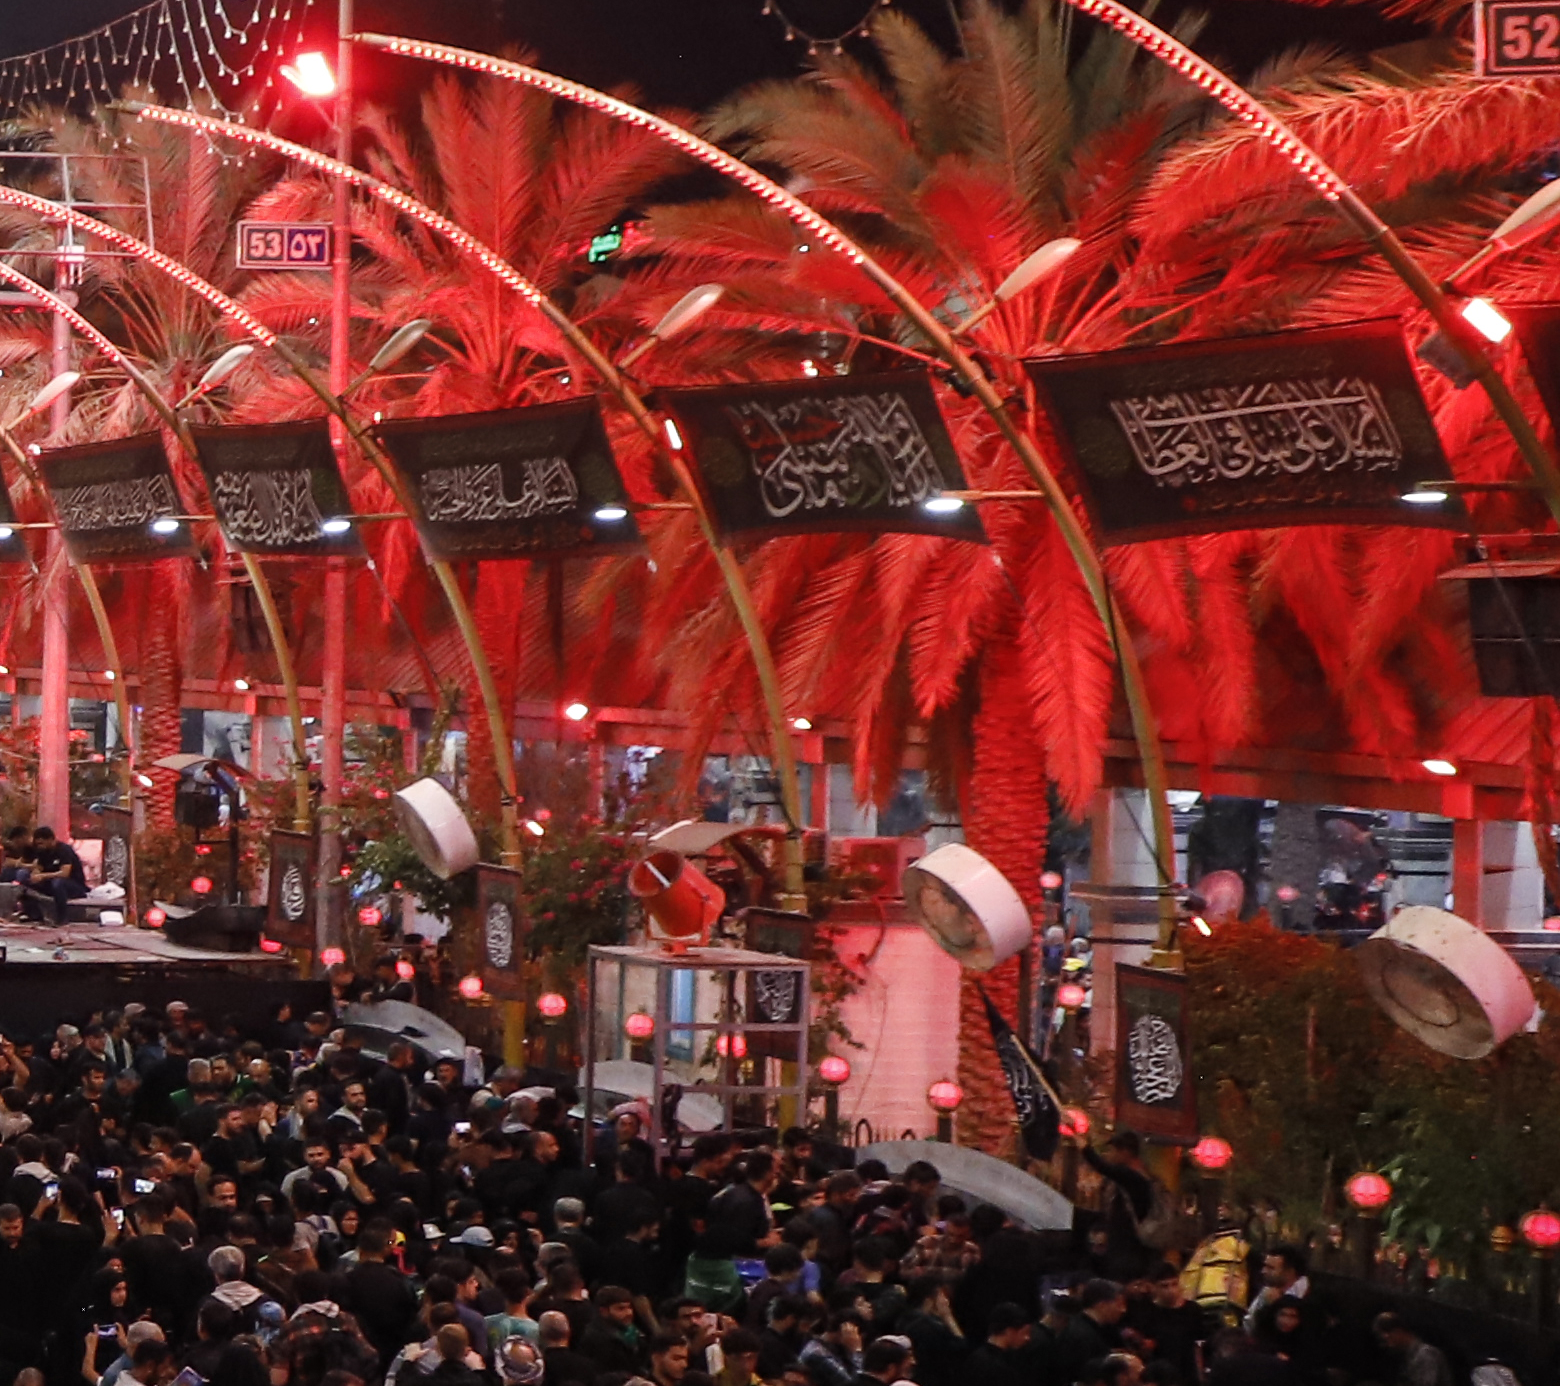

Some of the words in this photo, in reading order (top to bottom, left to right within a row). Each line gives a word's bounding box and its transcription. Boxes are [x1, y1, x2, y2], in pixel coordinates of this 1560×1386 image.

[1503, 14, 1560, 60] 52
[250, 231, 282, 259] 53
[290, 232, 323, 260] ٥٣
